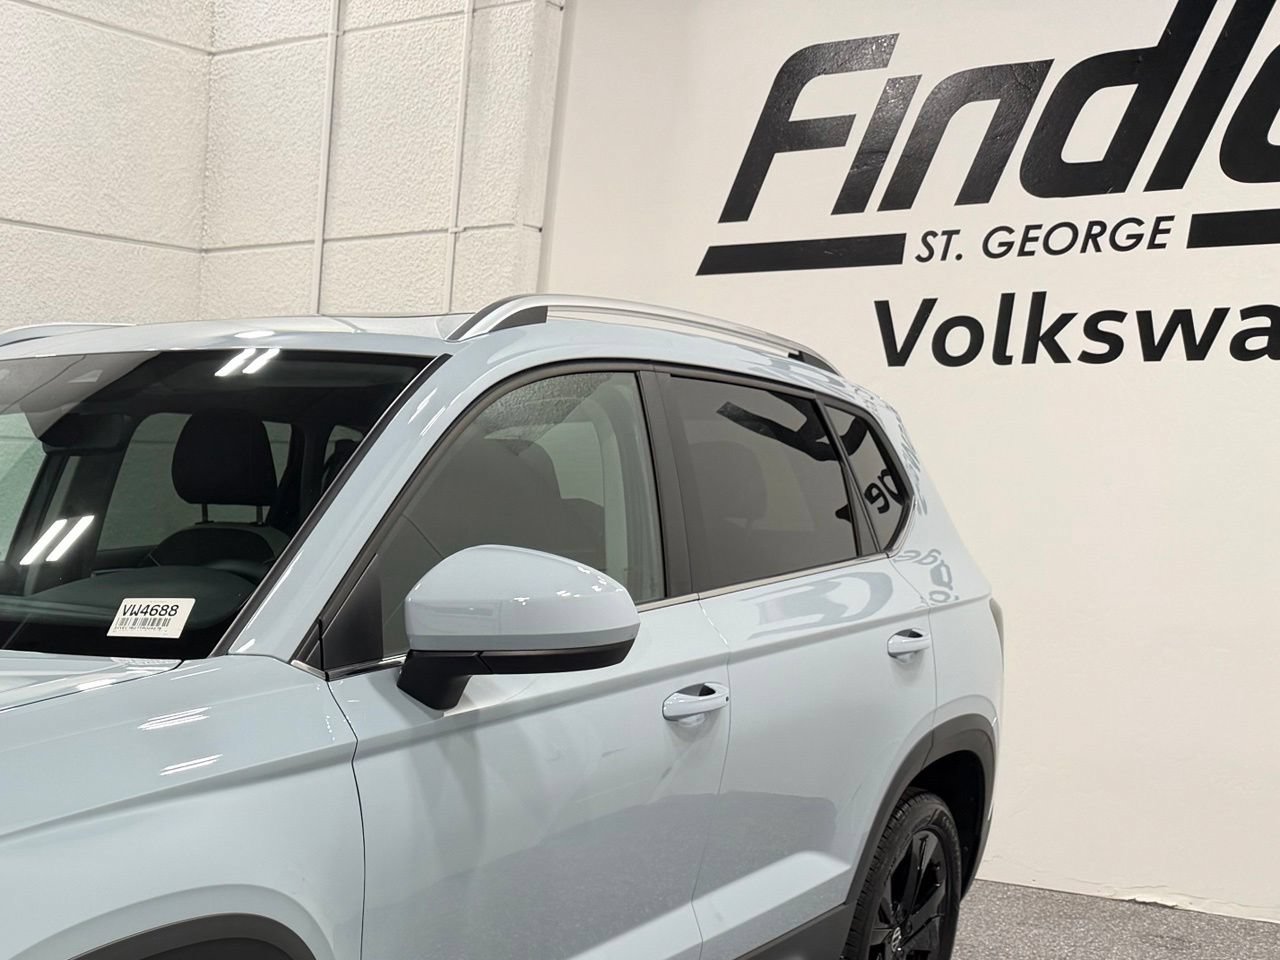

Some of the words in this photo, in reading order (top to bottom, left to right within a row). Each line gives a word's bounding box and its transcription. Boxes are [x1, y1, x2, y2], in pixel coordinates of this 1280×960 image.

[915, 230, 963, 264] ST.
[981, 215, 1176, 260] GEORGE
[874, 290, 1280, 368] Volkswa
[122, 604, 179, 617] VW4688
